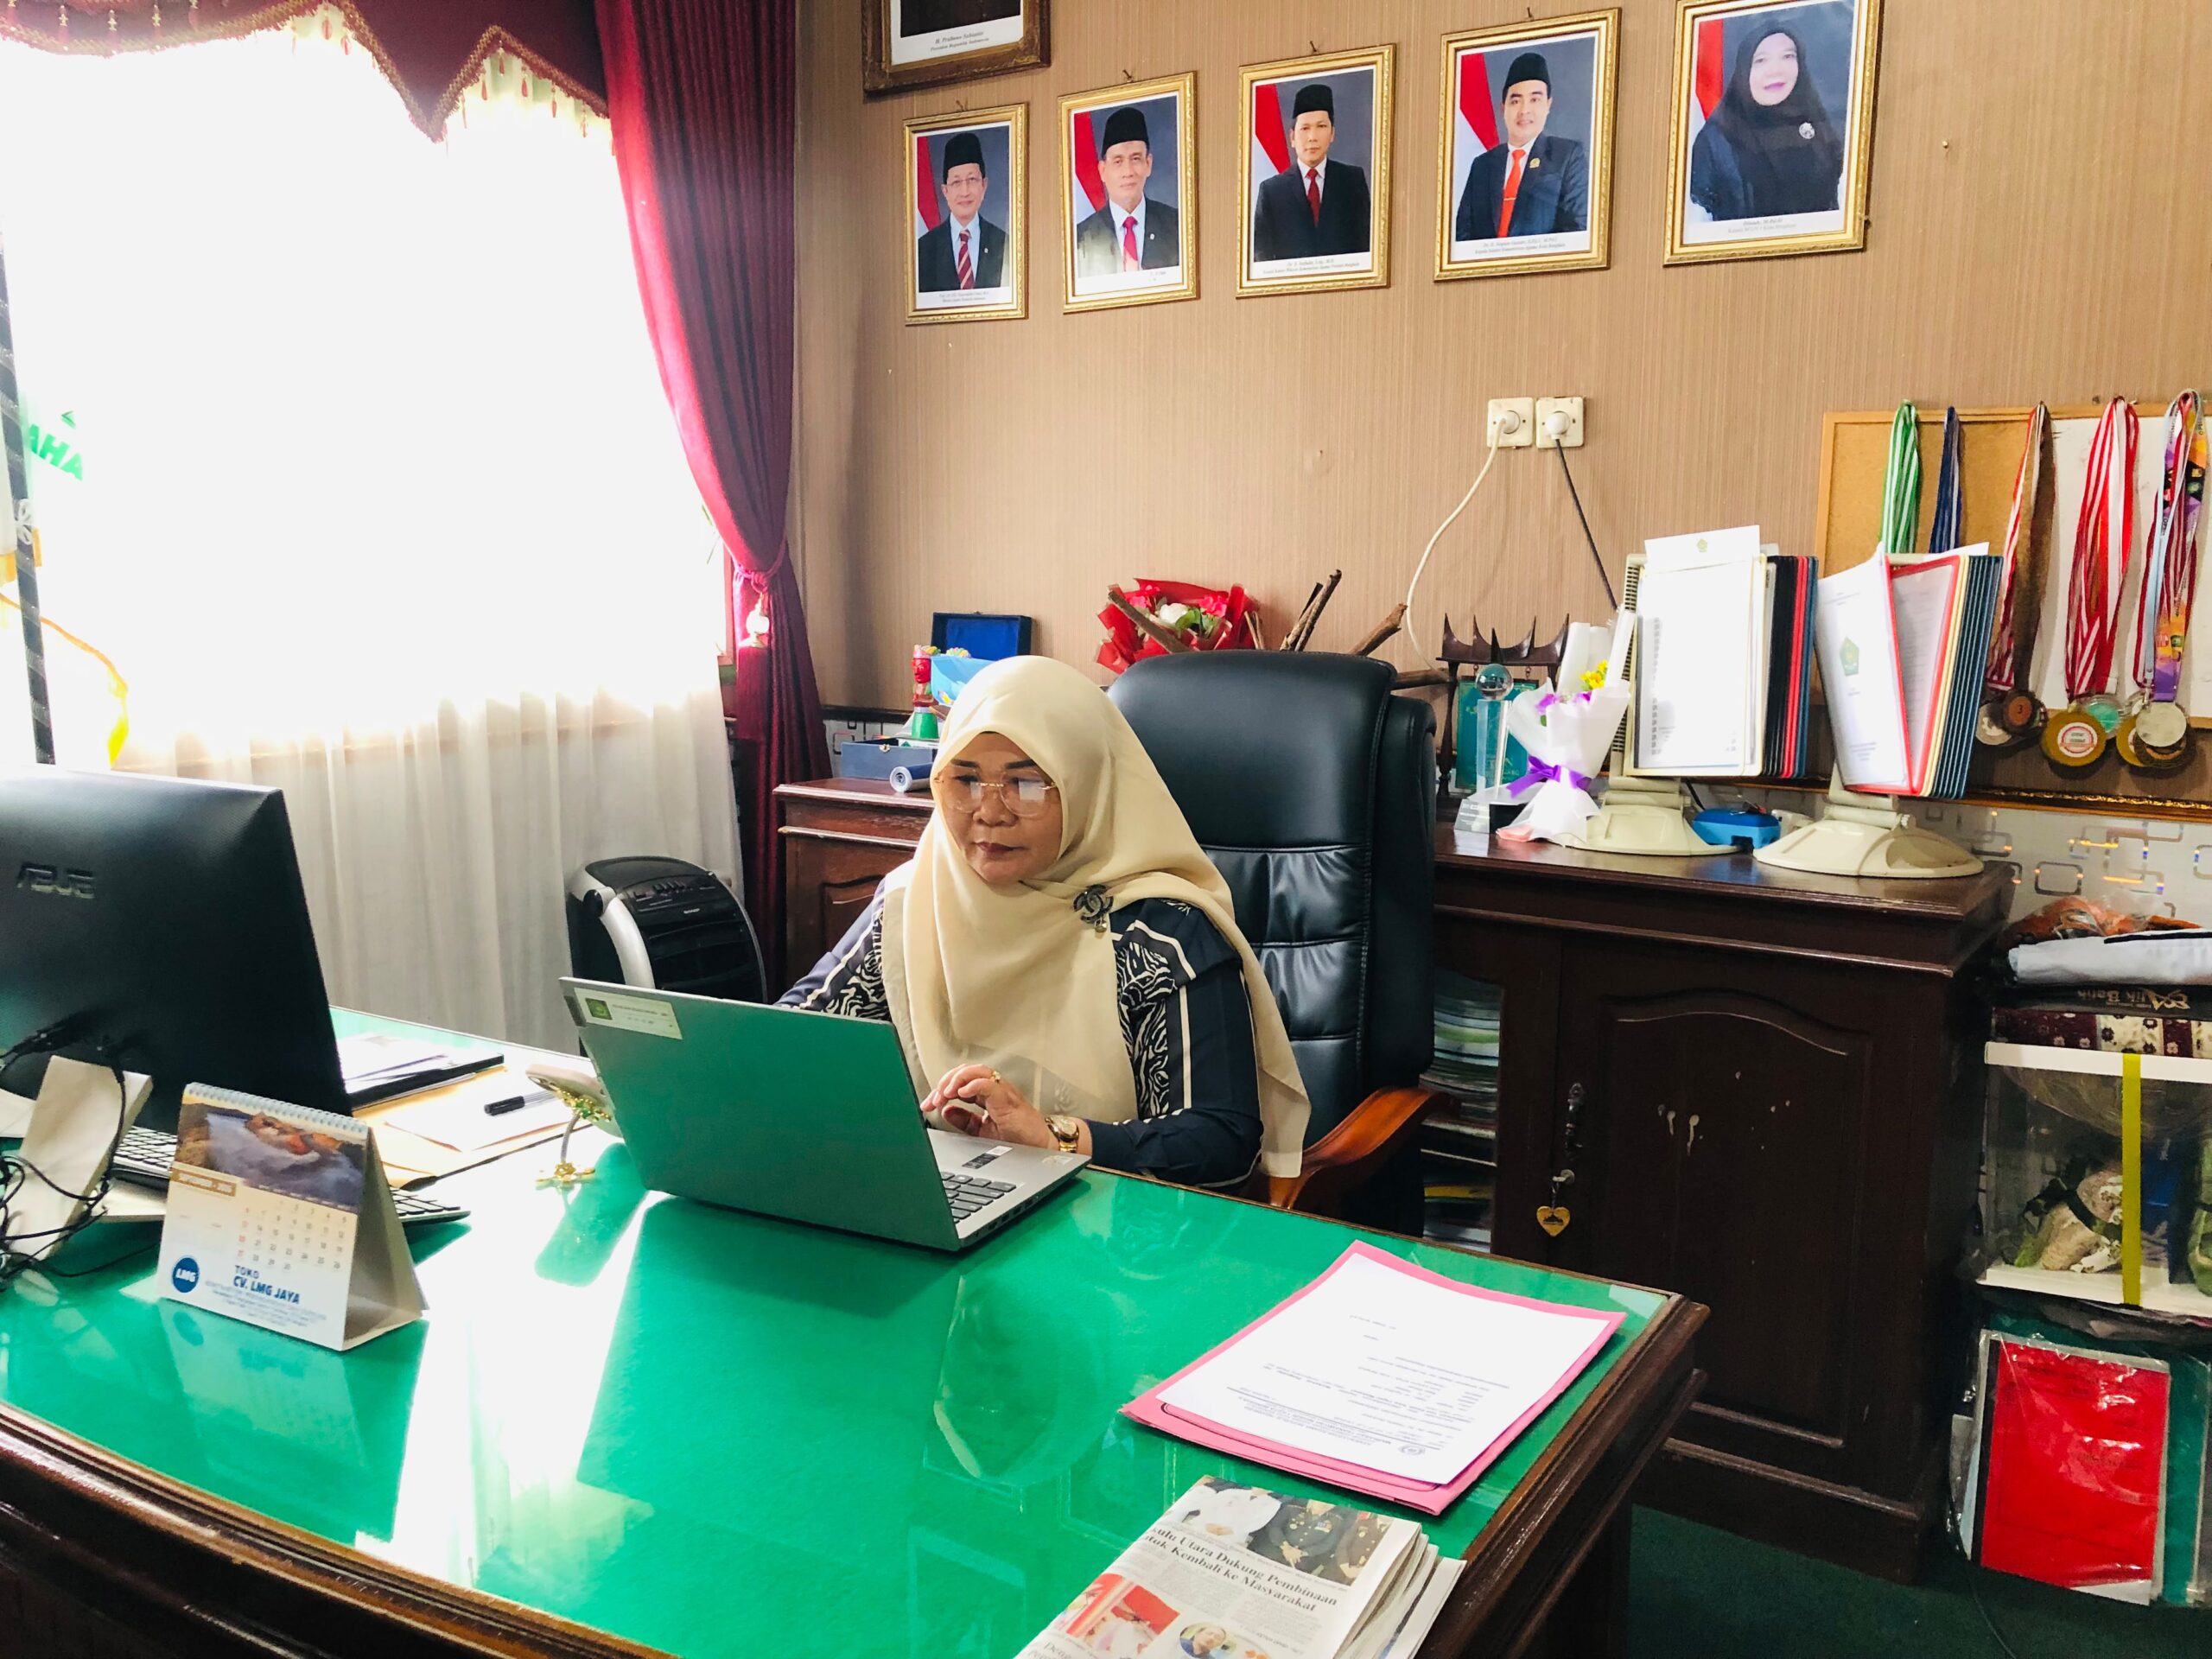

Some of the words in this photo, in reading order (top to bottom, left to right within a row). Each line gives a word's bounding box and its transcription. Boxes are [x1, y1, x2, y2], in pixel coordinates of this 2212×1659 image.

[2017, 704, 2024, 715] 3
[175, 1268, 198, 1283] LMG
[235, 1265, 259, 1280] TOKO
[233, 1275, 248, 1289] CV.
[251, 1281, 272, 1296] LMG
[273, 1286, 301, 1304] JAYA
[1171, 1547, 1223, 1573] Kembali
[1224, 1568, 1239, 1580] ke
[1241, 1576, 1318, 1611] Masyarakat
[1179, 1537, 1214, 1557] Utara
[1216, 1552, 1265, 1580] Dukung
[1267, 1573, 1338, 1607] Pembinaan
